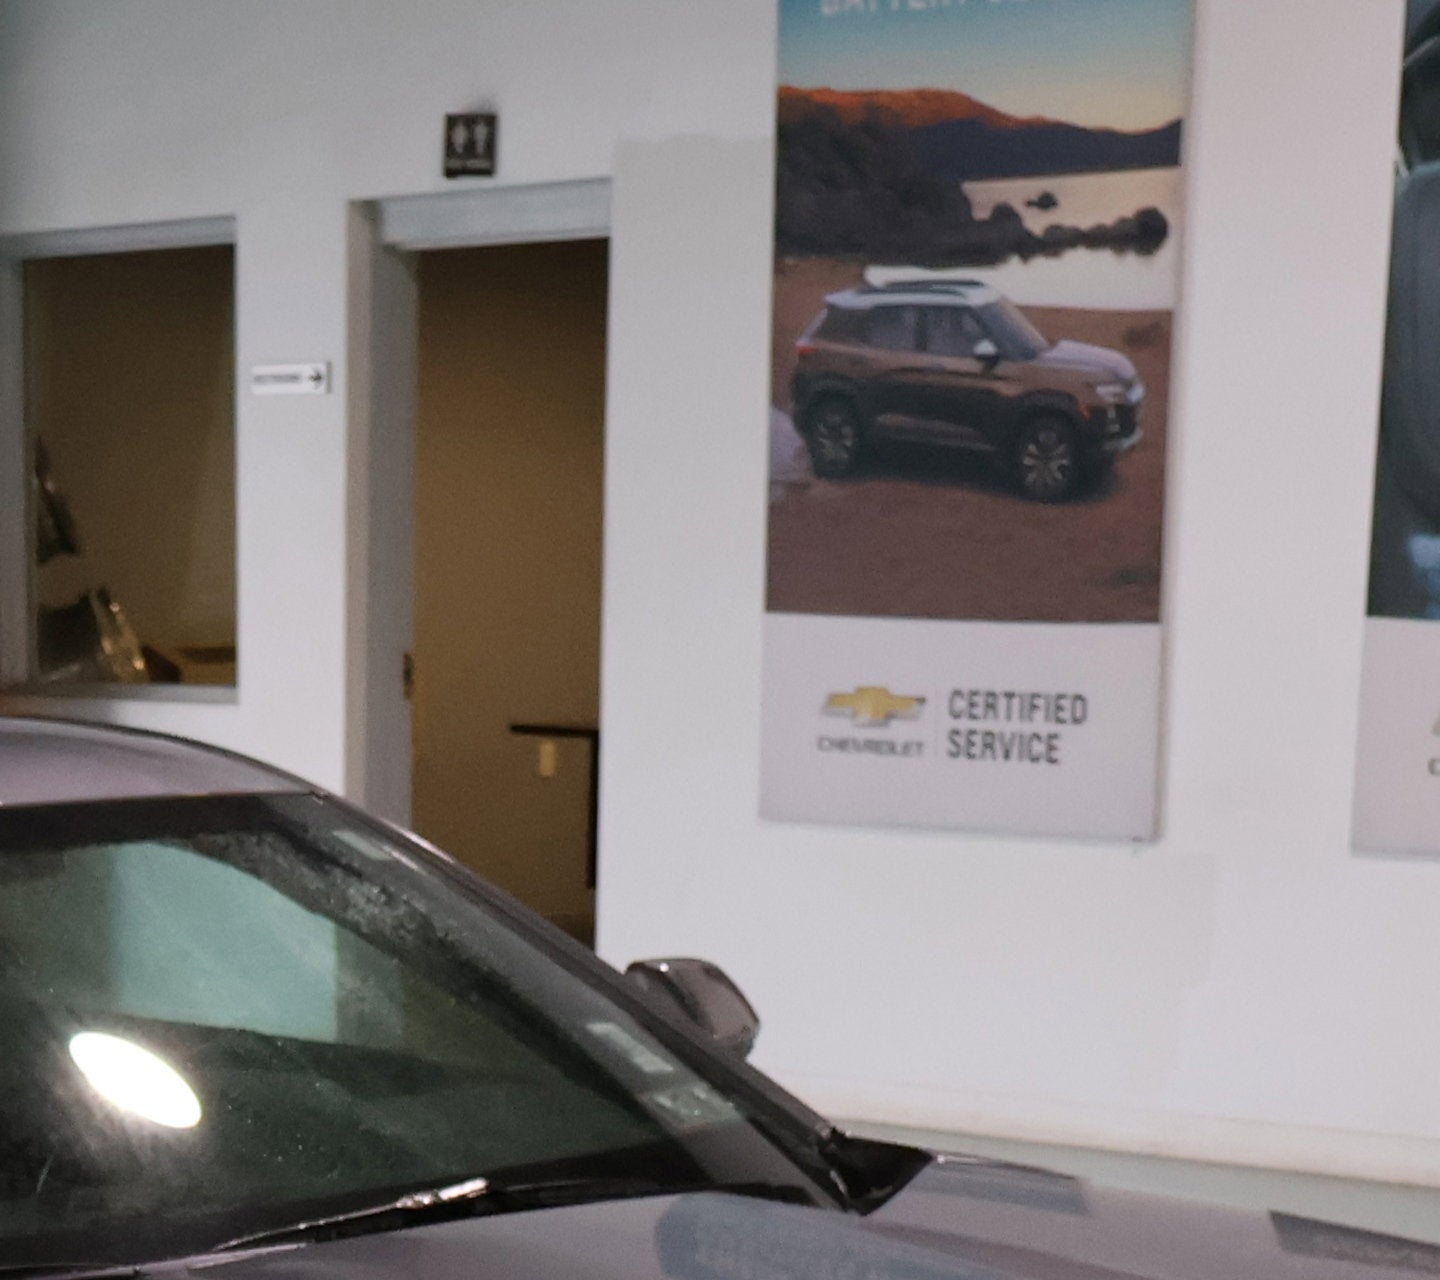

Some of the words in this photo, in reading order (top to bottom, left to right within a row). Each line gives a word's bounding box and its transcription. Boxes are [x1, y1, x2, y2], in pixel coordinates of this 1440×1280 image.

[946, 688, 1088, 725] CERTIFIED
[818, 736, 923, 757] CHEVROLET
[946, 728, 1062, 765] SERVICE
